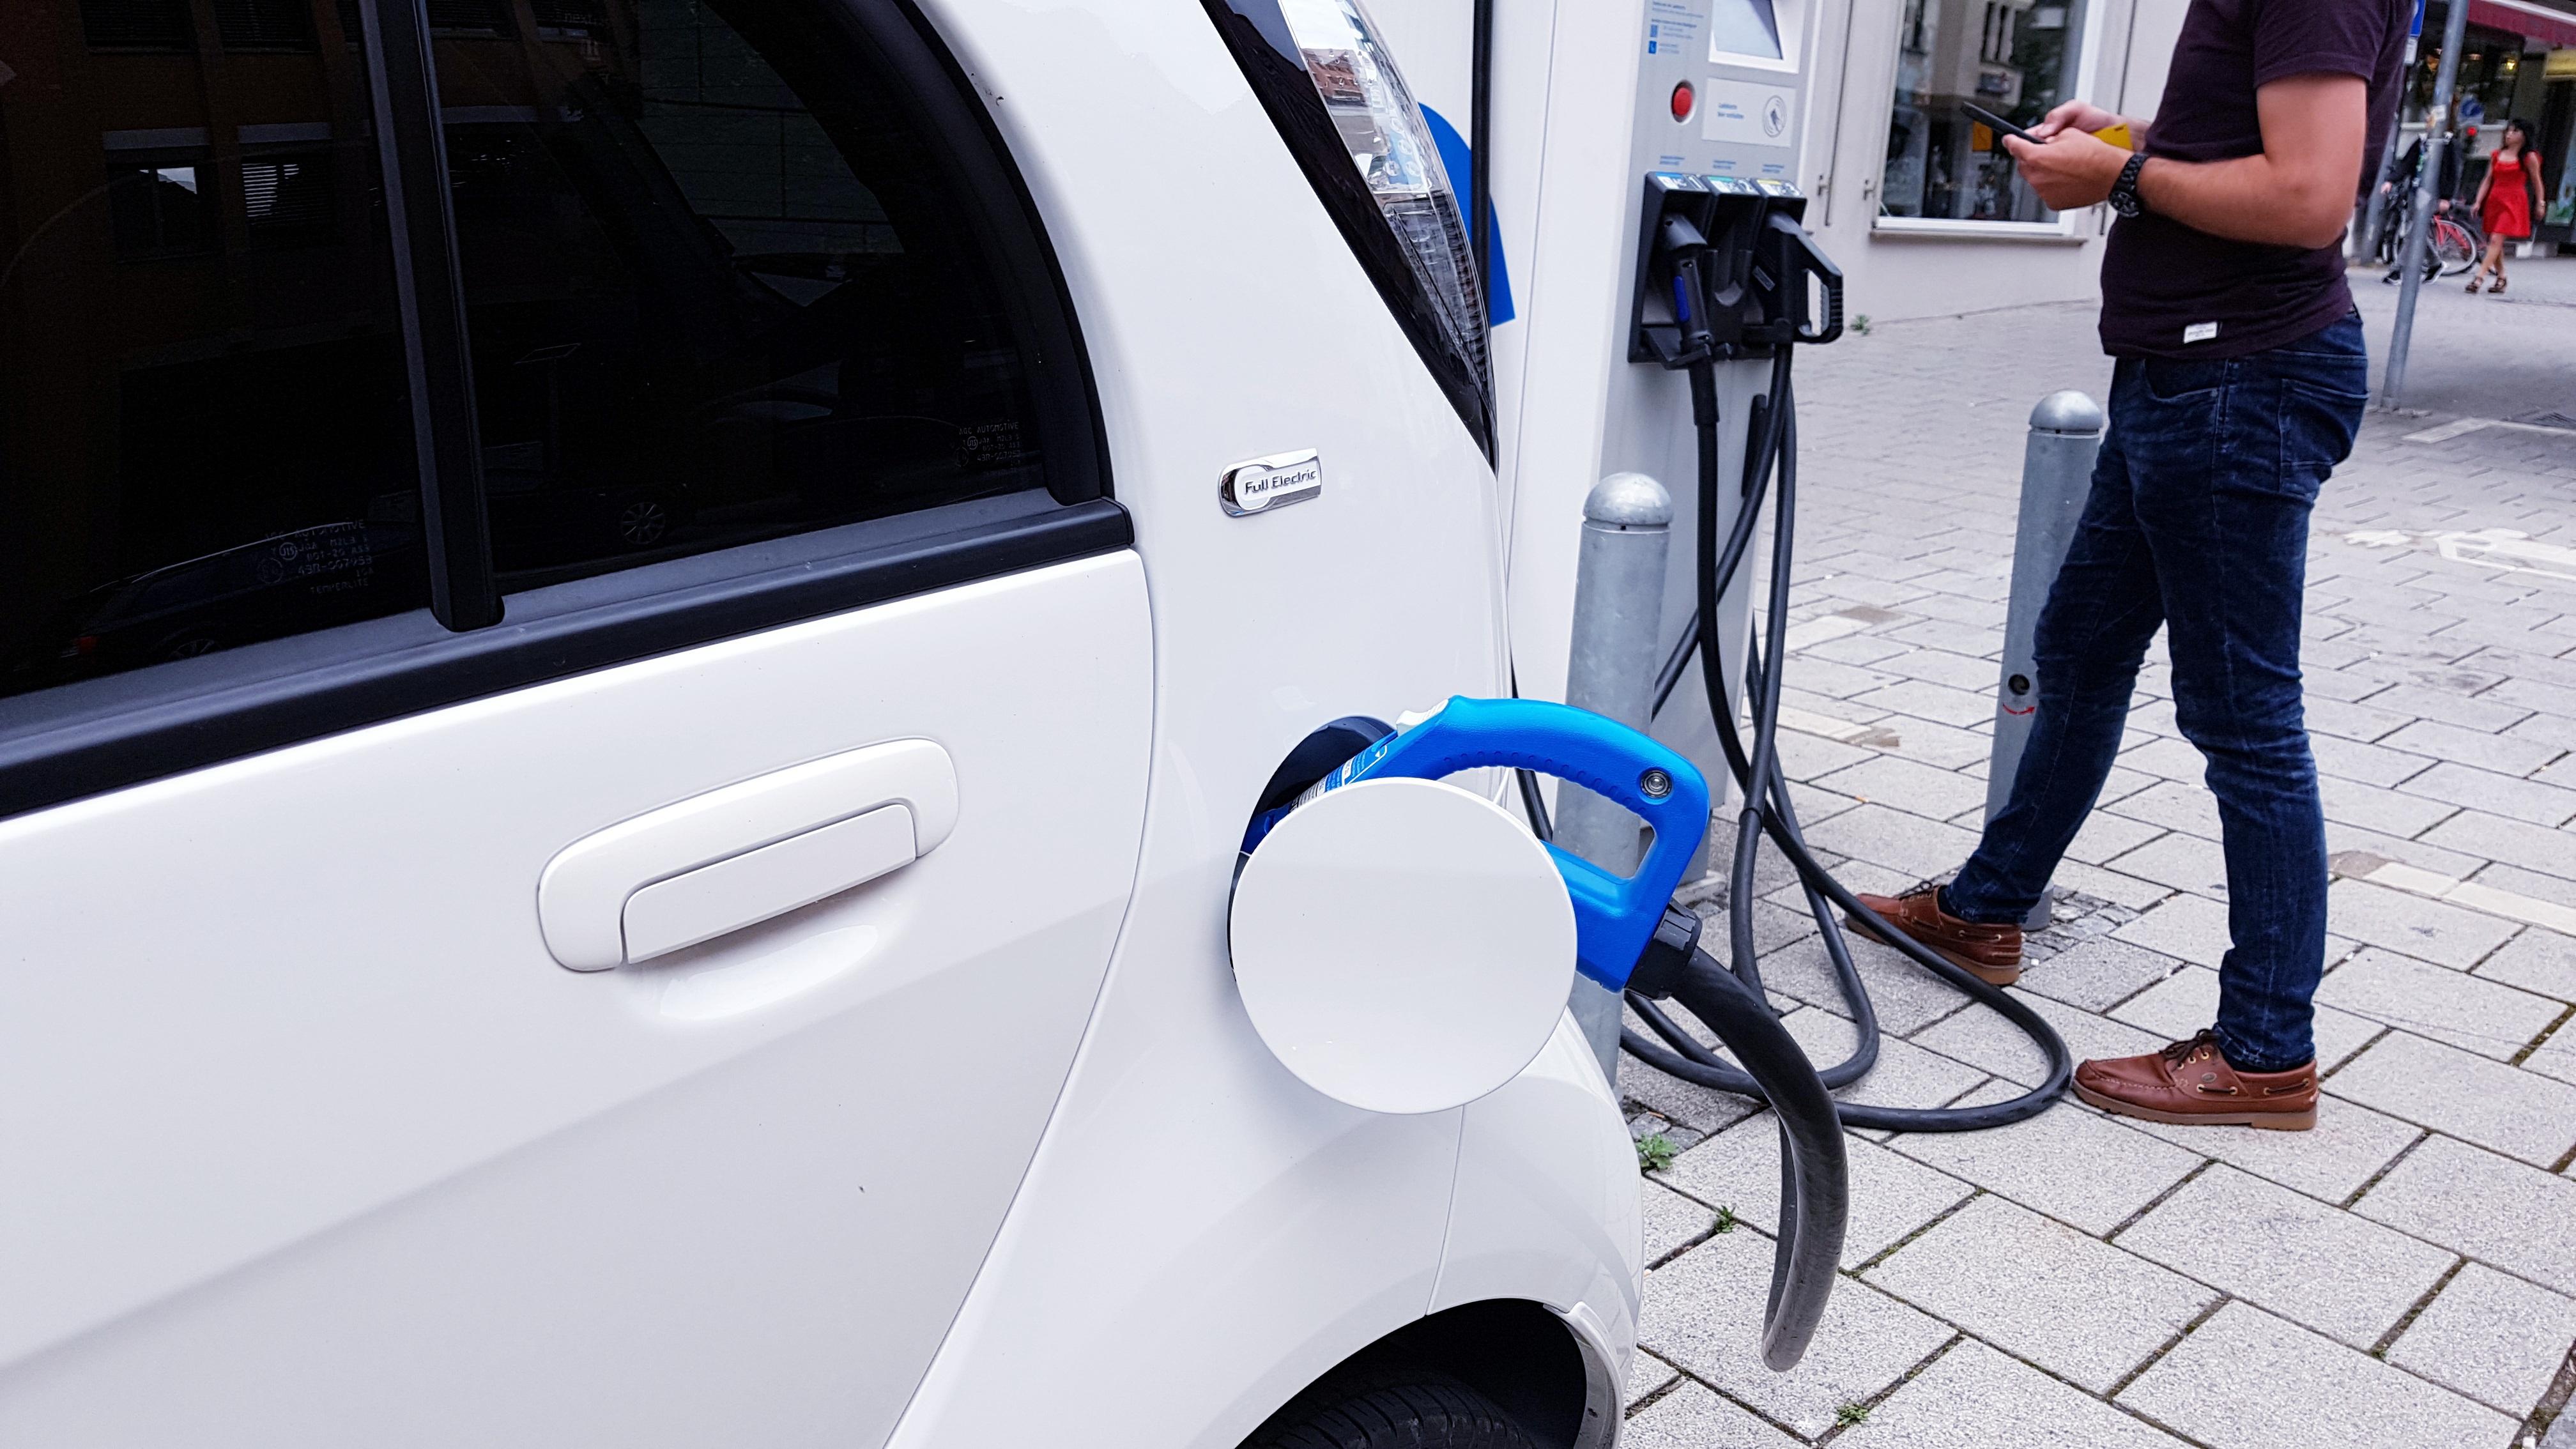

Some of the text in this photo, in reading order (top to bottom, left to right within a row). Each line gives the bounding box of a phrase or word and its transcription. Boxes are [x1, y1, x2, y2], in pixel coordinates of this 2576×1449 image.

[977, 421, 1019, 433] AUTOMOTIVE
[1245, 468, 1317, 495] Full Electric
